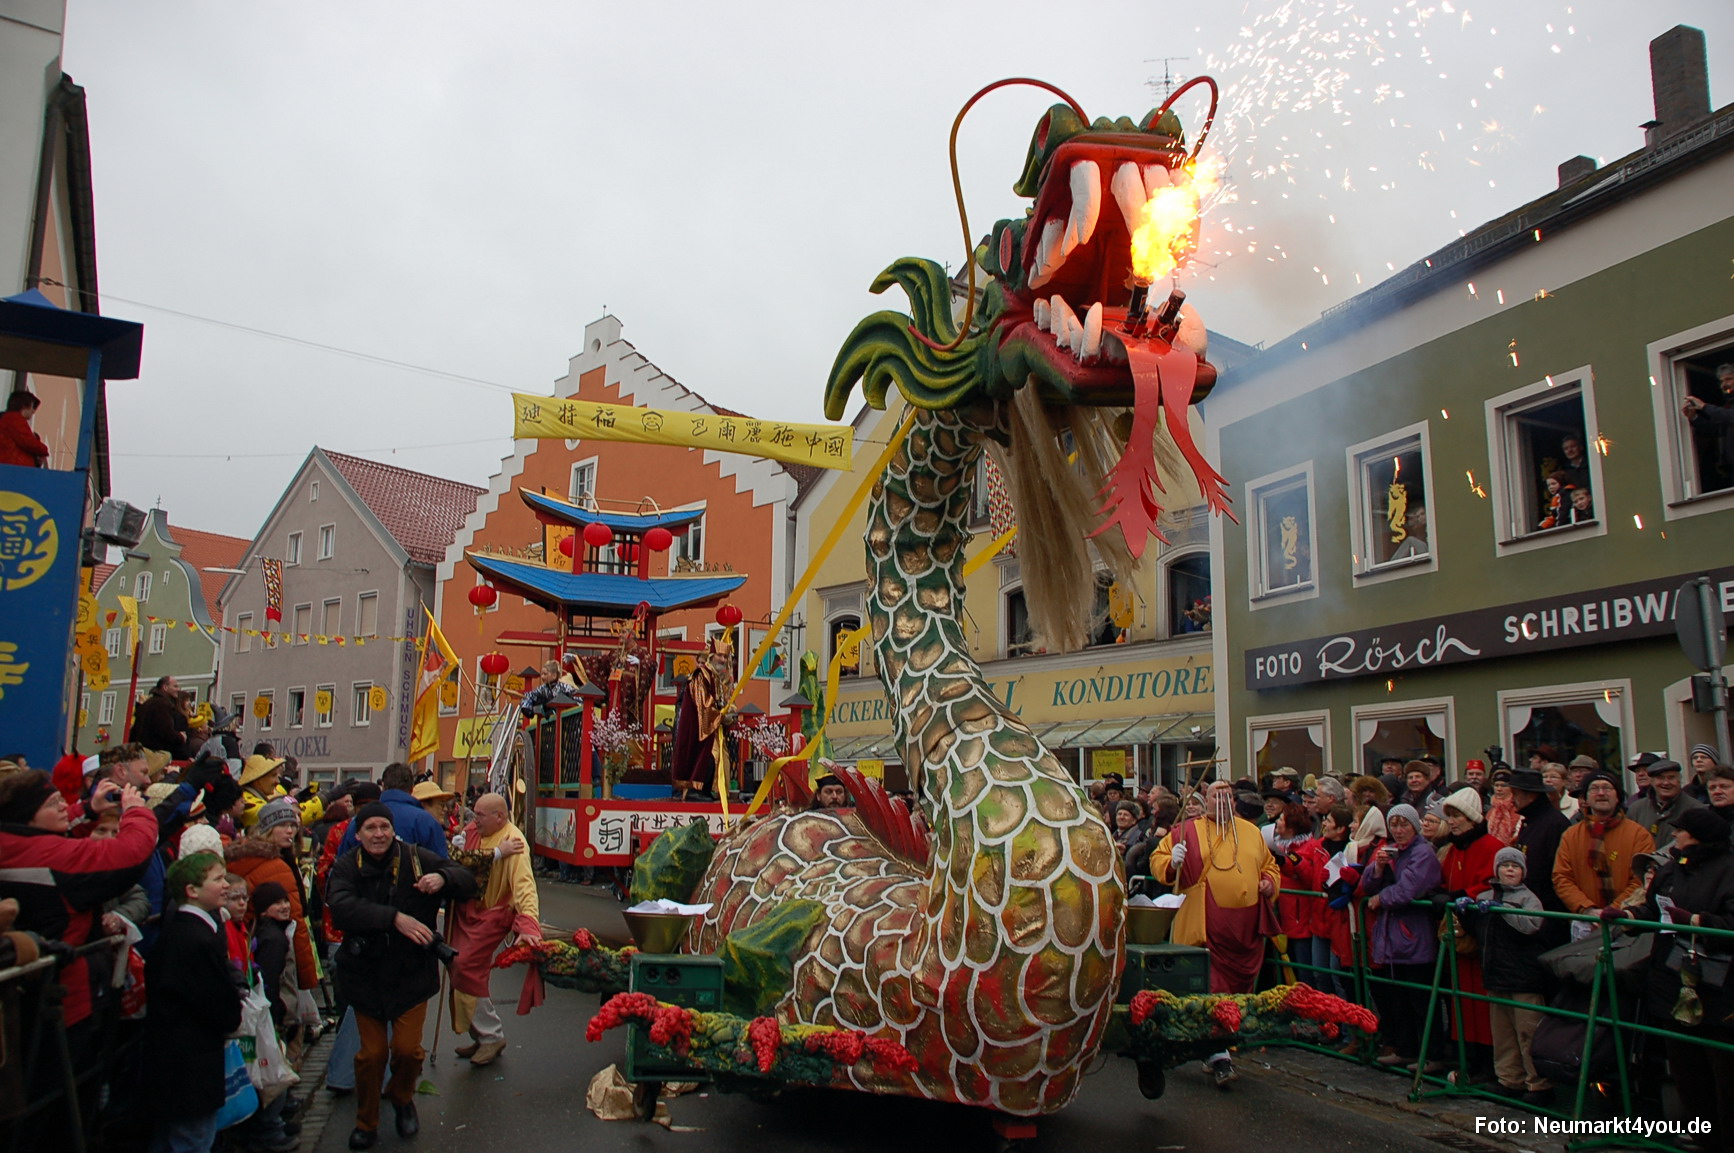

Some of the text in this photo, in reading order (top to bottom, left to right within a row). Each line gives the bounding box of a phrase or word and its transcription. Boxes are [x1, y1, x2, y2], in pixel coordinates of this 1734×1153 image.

[1256, 581, 1734, 679] FOTO Rösch SCHREIBWE
[399, 608, 415, 747] UHREN SCHMUCK
[1052, 665, 1215, 706] KONDITORE
[294, 735, 331, 757] OEXL
